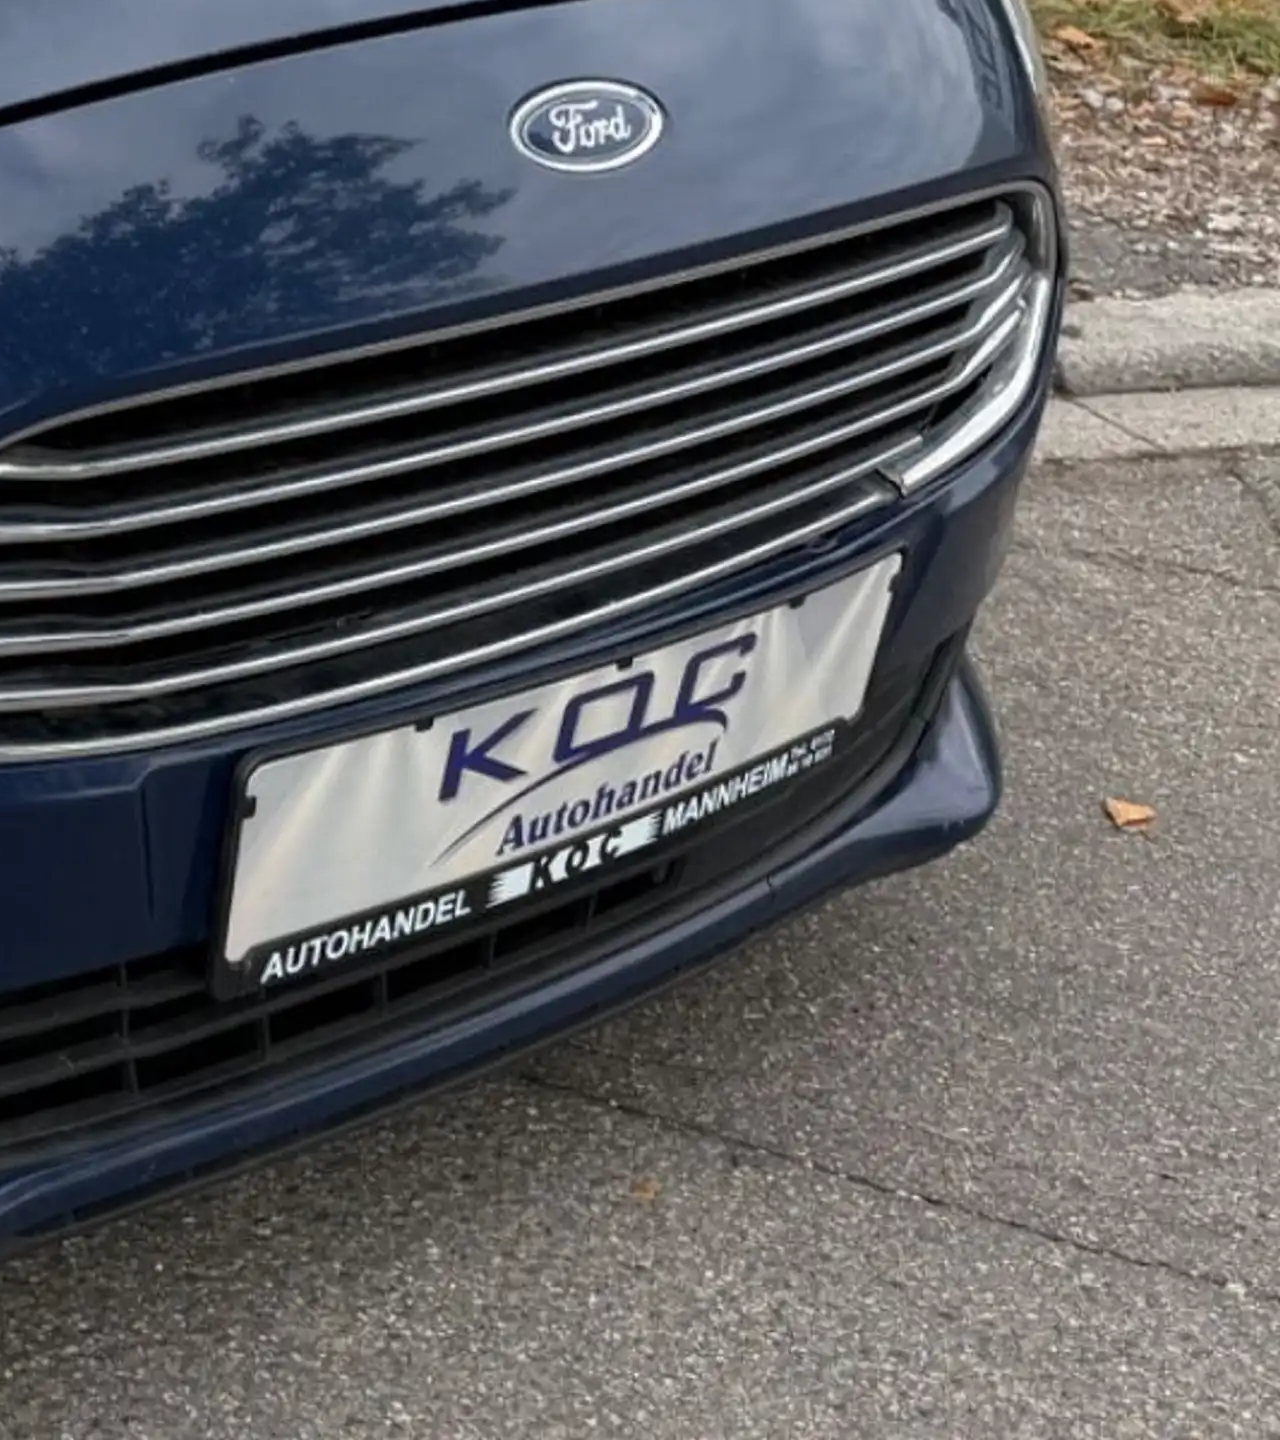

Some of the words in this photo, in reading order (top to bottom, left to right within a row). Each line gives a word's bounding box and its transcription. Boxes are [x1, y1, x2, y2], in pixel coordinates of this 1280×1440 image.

[548, 99, 632, 154] Ford
[496, 737, 720, 856] Autohandel
[259, 888, 472, 984] AUTOHANDEL
[661, 753, 789, 837] MANNHEIM
